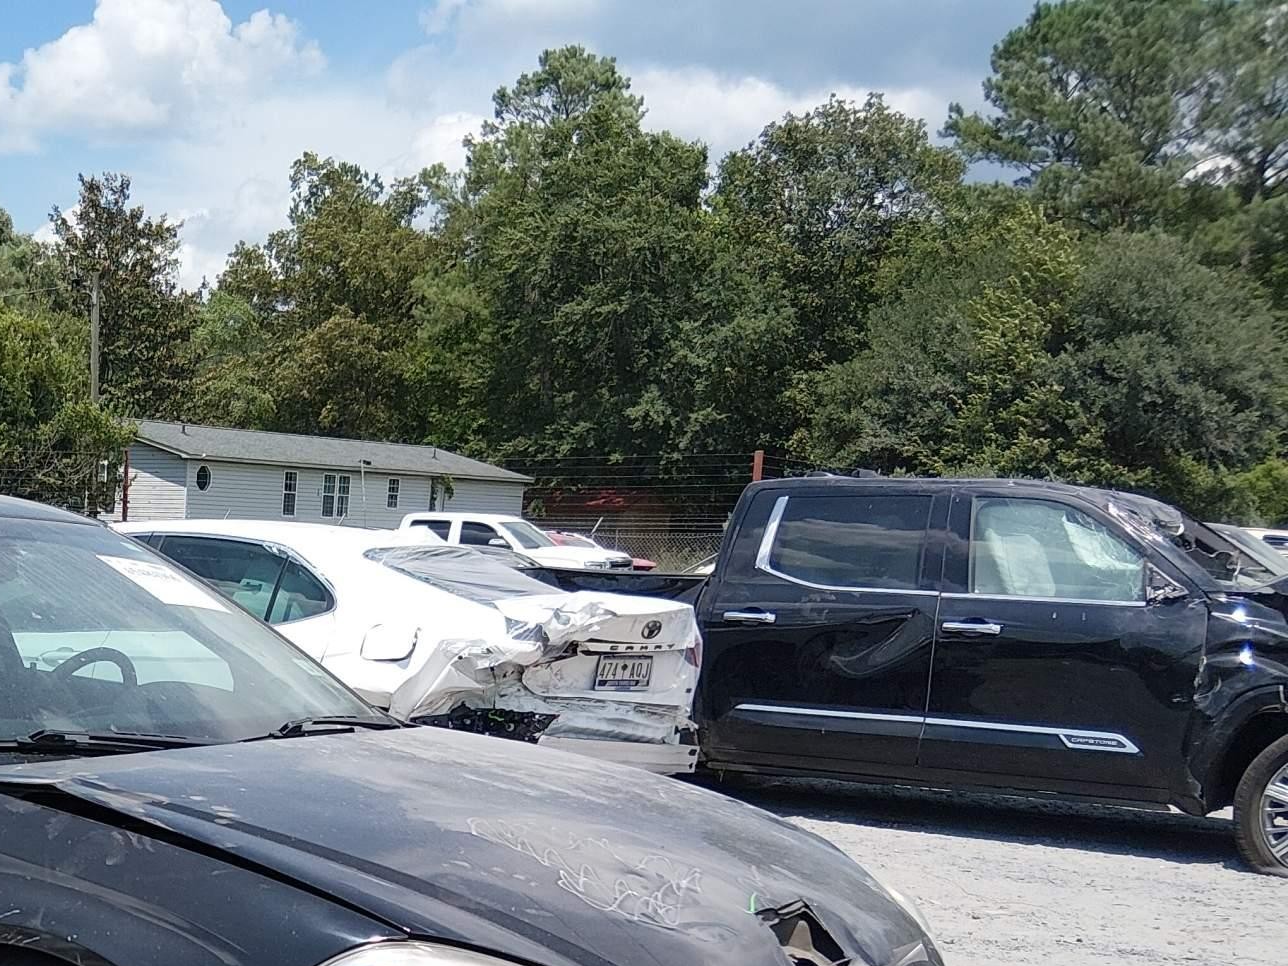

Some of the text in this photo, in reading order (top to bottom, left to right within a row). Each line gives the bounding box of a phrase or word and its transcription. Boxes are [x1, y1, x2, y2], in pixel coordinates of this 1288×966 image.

[609, 643, 676, 651] CAMRY
[599, 662, 650, 679] 474 AQJ
[1071, 737, 1118, 746] CAPSTONE
